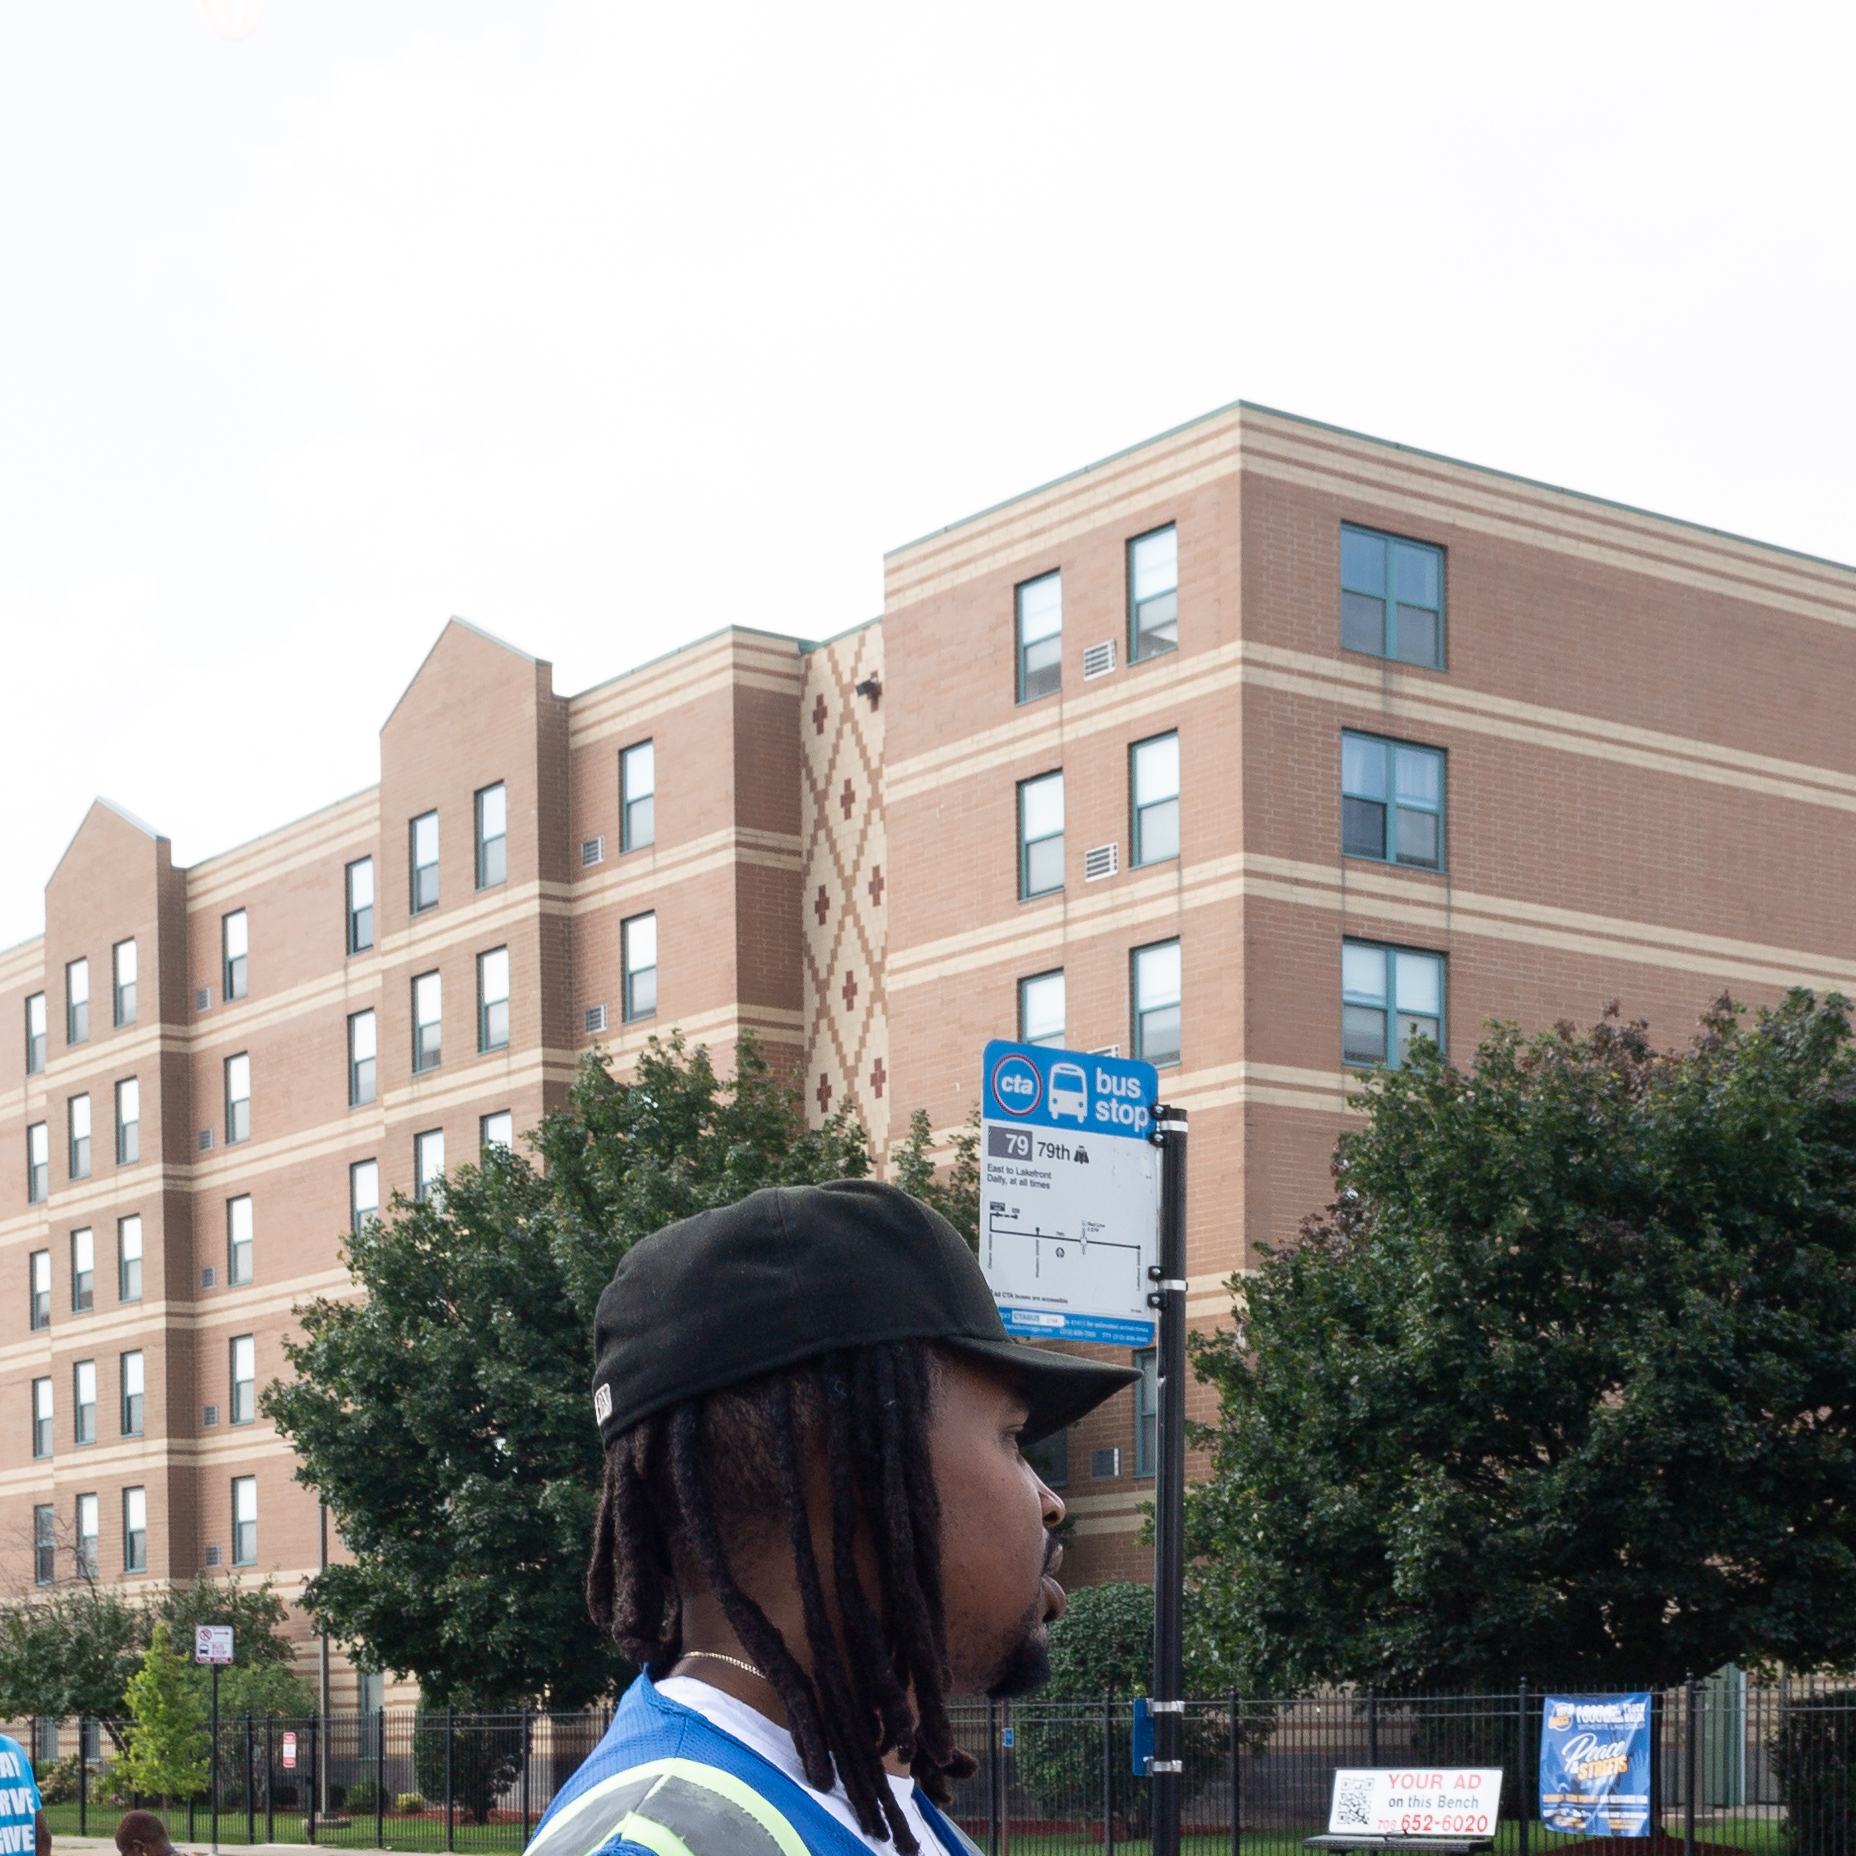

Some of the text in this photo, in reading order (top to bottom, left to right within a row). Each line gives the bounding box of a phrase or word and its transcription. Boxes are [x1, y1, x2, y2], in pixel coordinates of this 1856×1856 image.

[1001, 1074, 1034, 1096] cta
[1096, 1066, 1142, 1099] bus
[1095, 1098, 1150, 1133] stop
[1005, 1133, 1030, 1156] 79
[1037, 1141, 1071, 1161] 79th
[987, 1163, 1052, 1180] East to Lakefront
[1010, 1177, 1018, 1185] at
[1019, 1178, 1028, 1187] all
[1029, 1178, 1051, 1190] times
[1561, 1732, 1626, 1773] Peace
[1578, 1754, 1629, 1780] STREETS
[1388, 1773, 1482, 1790] YOUR AD
[1388, 1794, 1479, 1809] on this Bench
[1377, 1813, 1488, 1833] 708 652-6020
